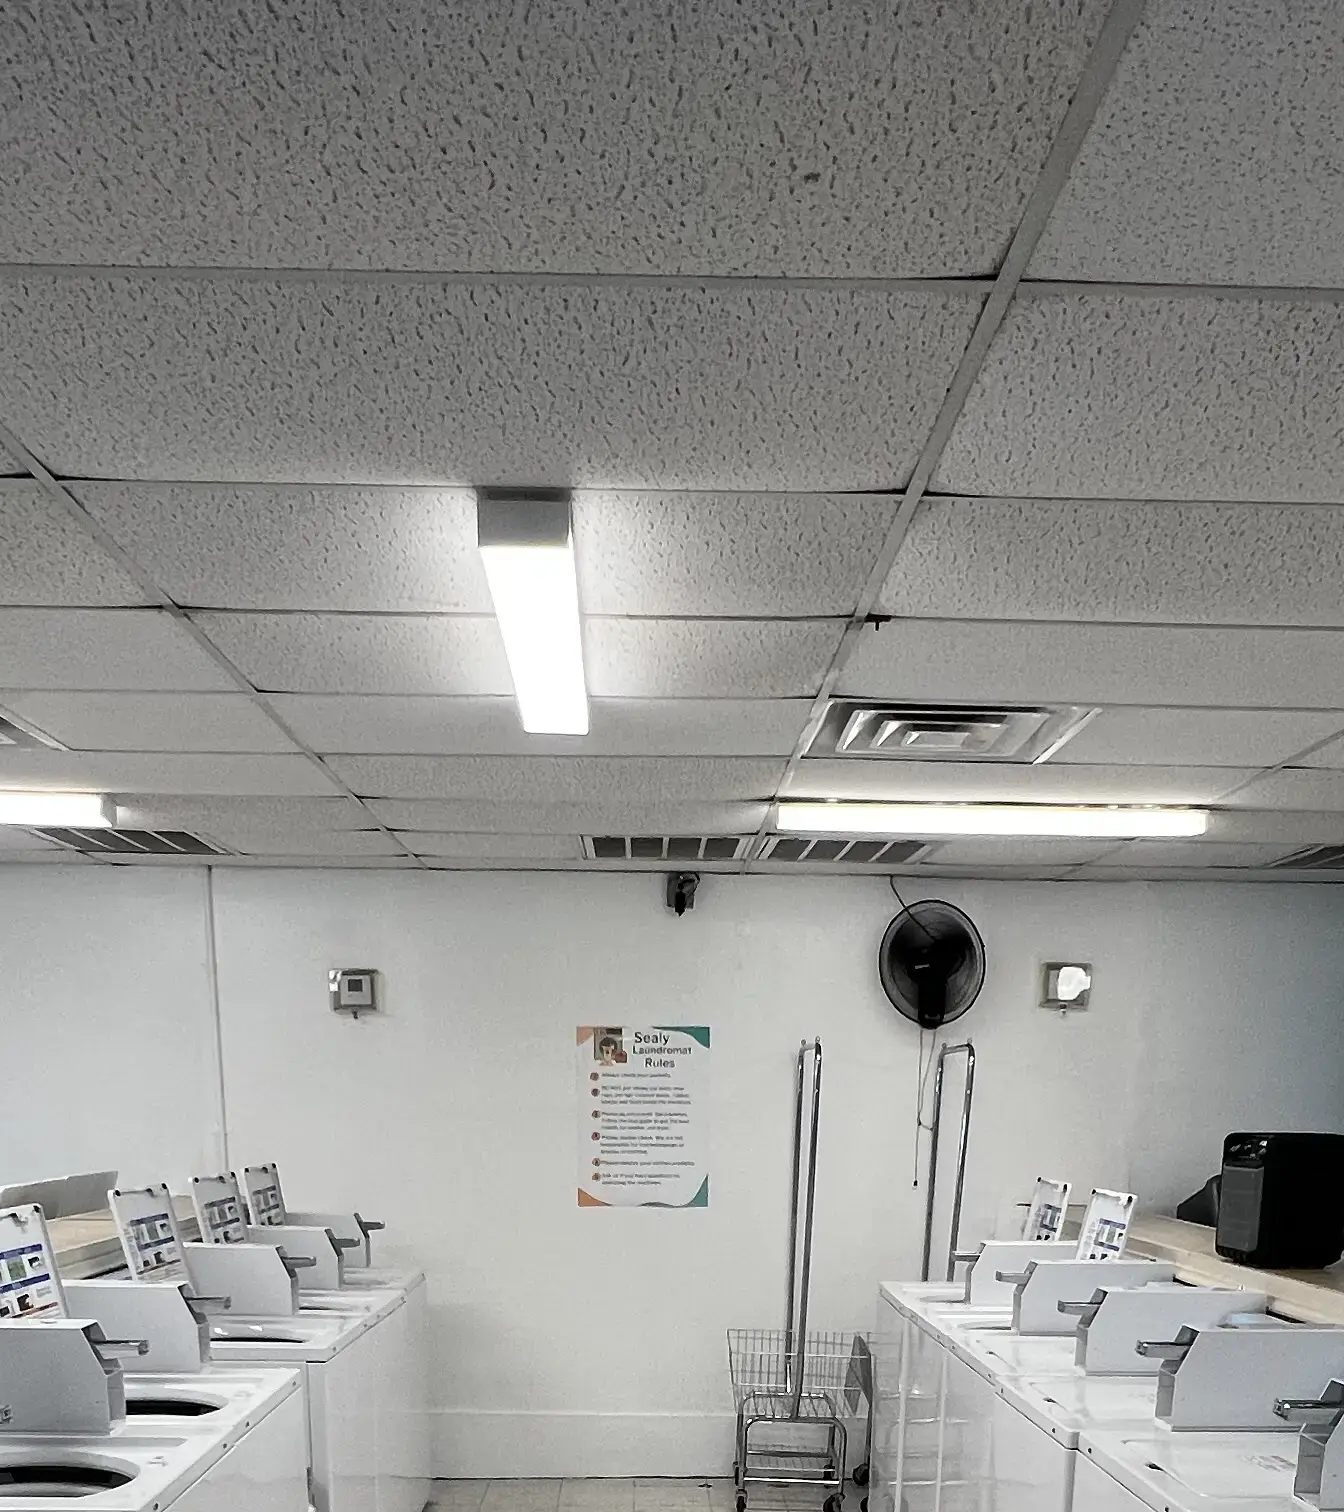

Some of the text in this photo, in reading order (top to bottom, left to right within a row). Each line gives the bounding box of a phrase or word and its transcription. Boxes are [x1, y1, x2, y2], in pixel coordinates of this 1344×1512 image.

[634, 1032, 670, 1045] Sealy
[632, 1045, 692, 1056] Laundromat
[645, 1058, 676, 1068] Rules
